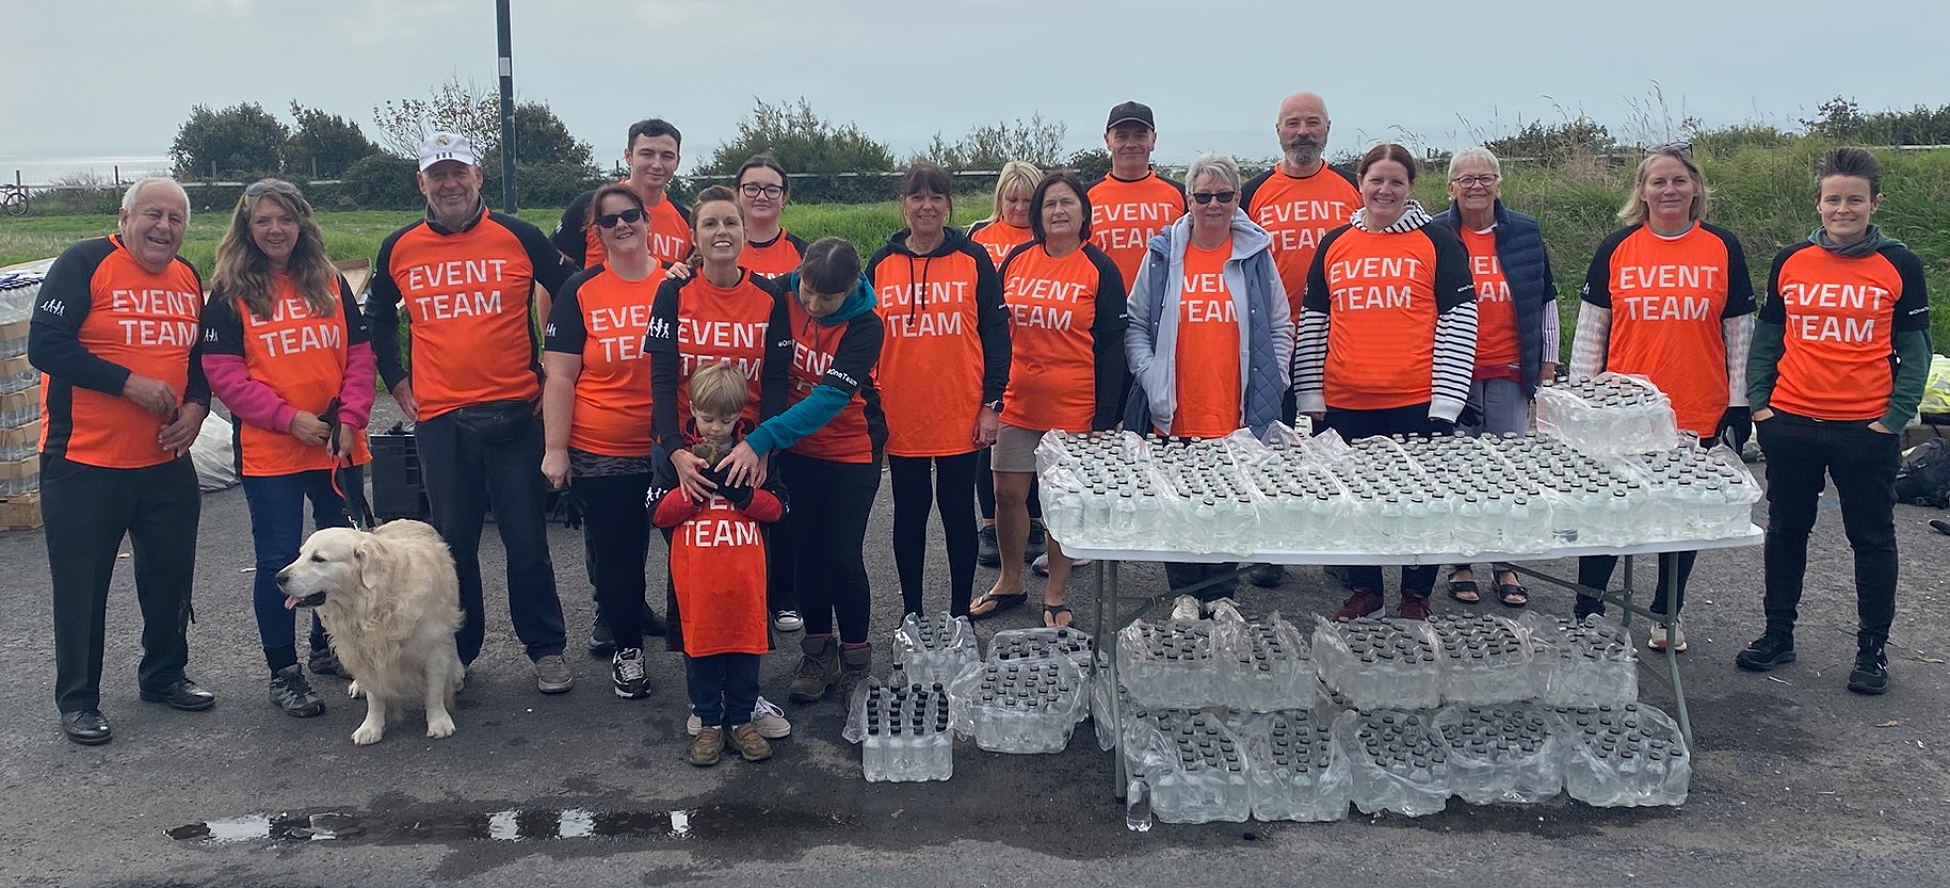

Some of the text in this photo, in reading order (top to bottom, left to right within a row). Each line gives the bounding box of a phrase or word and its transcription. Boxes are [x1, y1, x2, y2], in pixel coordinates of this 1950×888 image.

[1092, 203, 1173, 225] EVENT
[1260, 201, 1345, 227] EVENT
[409, 259, 507, 291] EVENT
[1329, 257, 1421, 284] EVENT
[1620, 265, 1718, 290] EVENT
[112, 289, 197, 317] EVENT
[882, 281, 968, 308] EVENT
[1005, 276, 1086, 304] EVENT
[1334, 285, 1412, 312] TEAM
[1783, 284, 1888, 310] EVENT
[415, 290, 502, 321] TEAM
[591, 305, 652, 331] EVE
[1624, 296, 1709, 322] TEAM
[118, 320, 198, 347] TEAM
[677, 318, 769, 348] EVENT
[888, 312, 962, 337] TEAM
[1789, 314, 1875, 342] TEAM
[258, 324, 340, 357] TEAM
[599, 335, 646, 362] TE
[682, 520, 759, 547] TEAM
